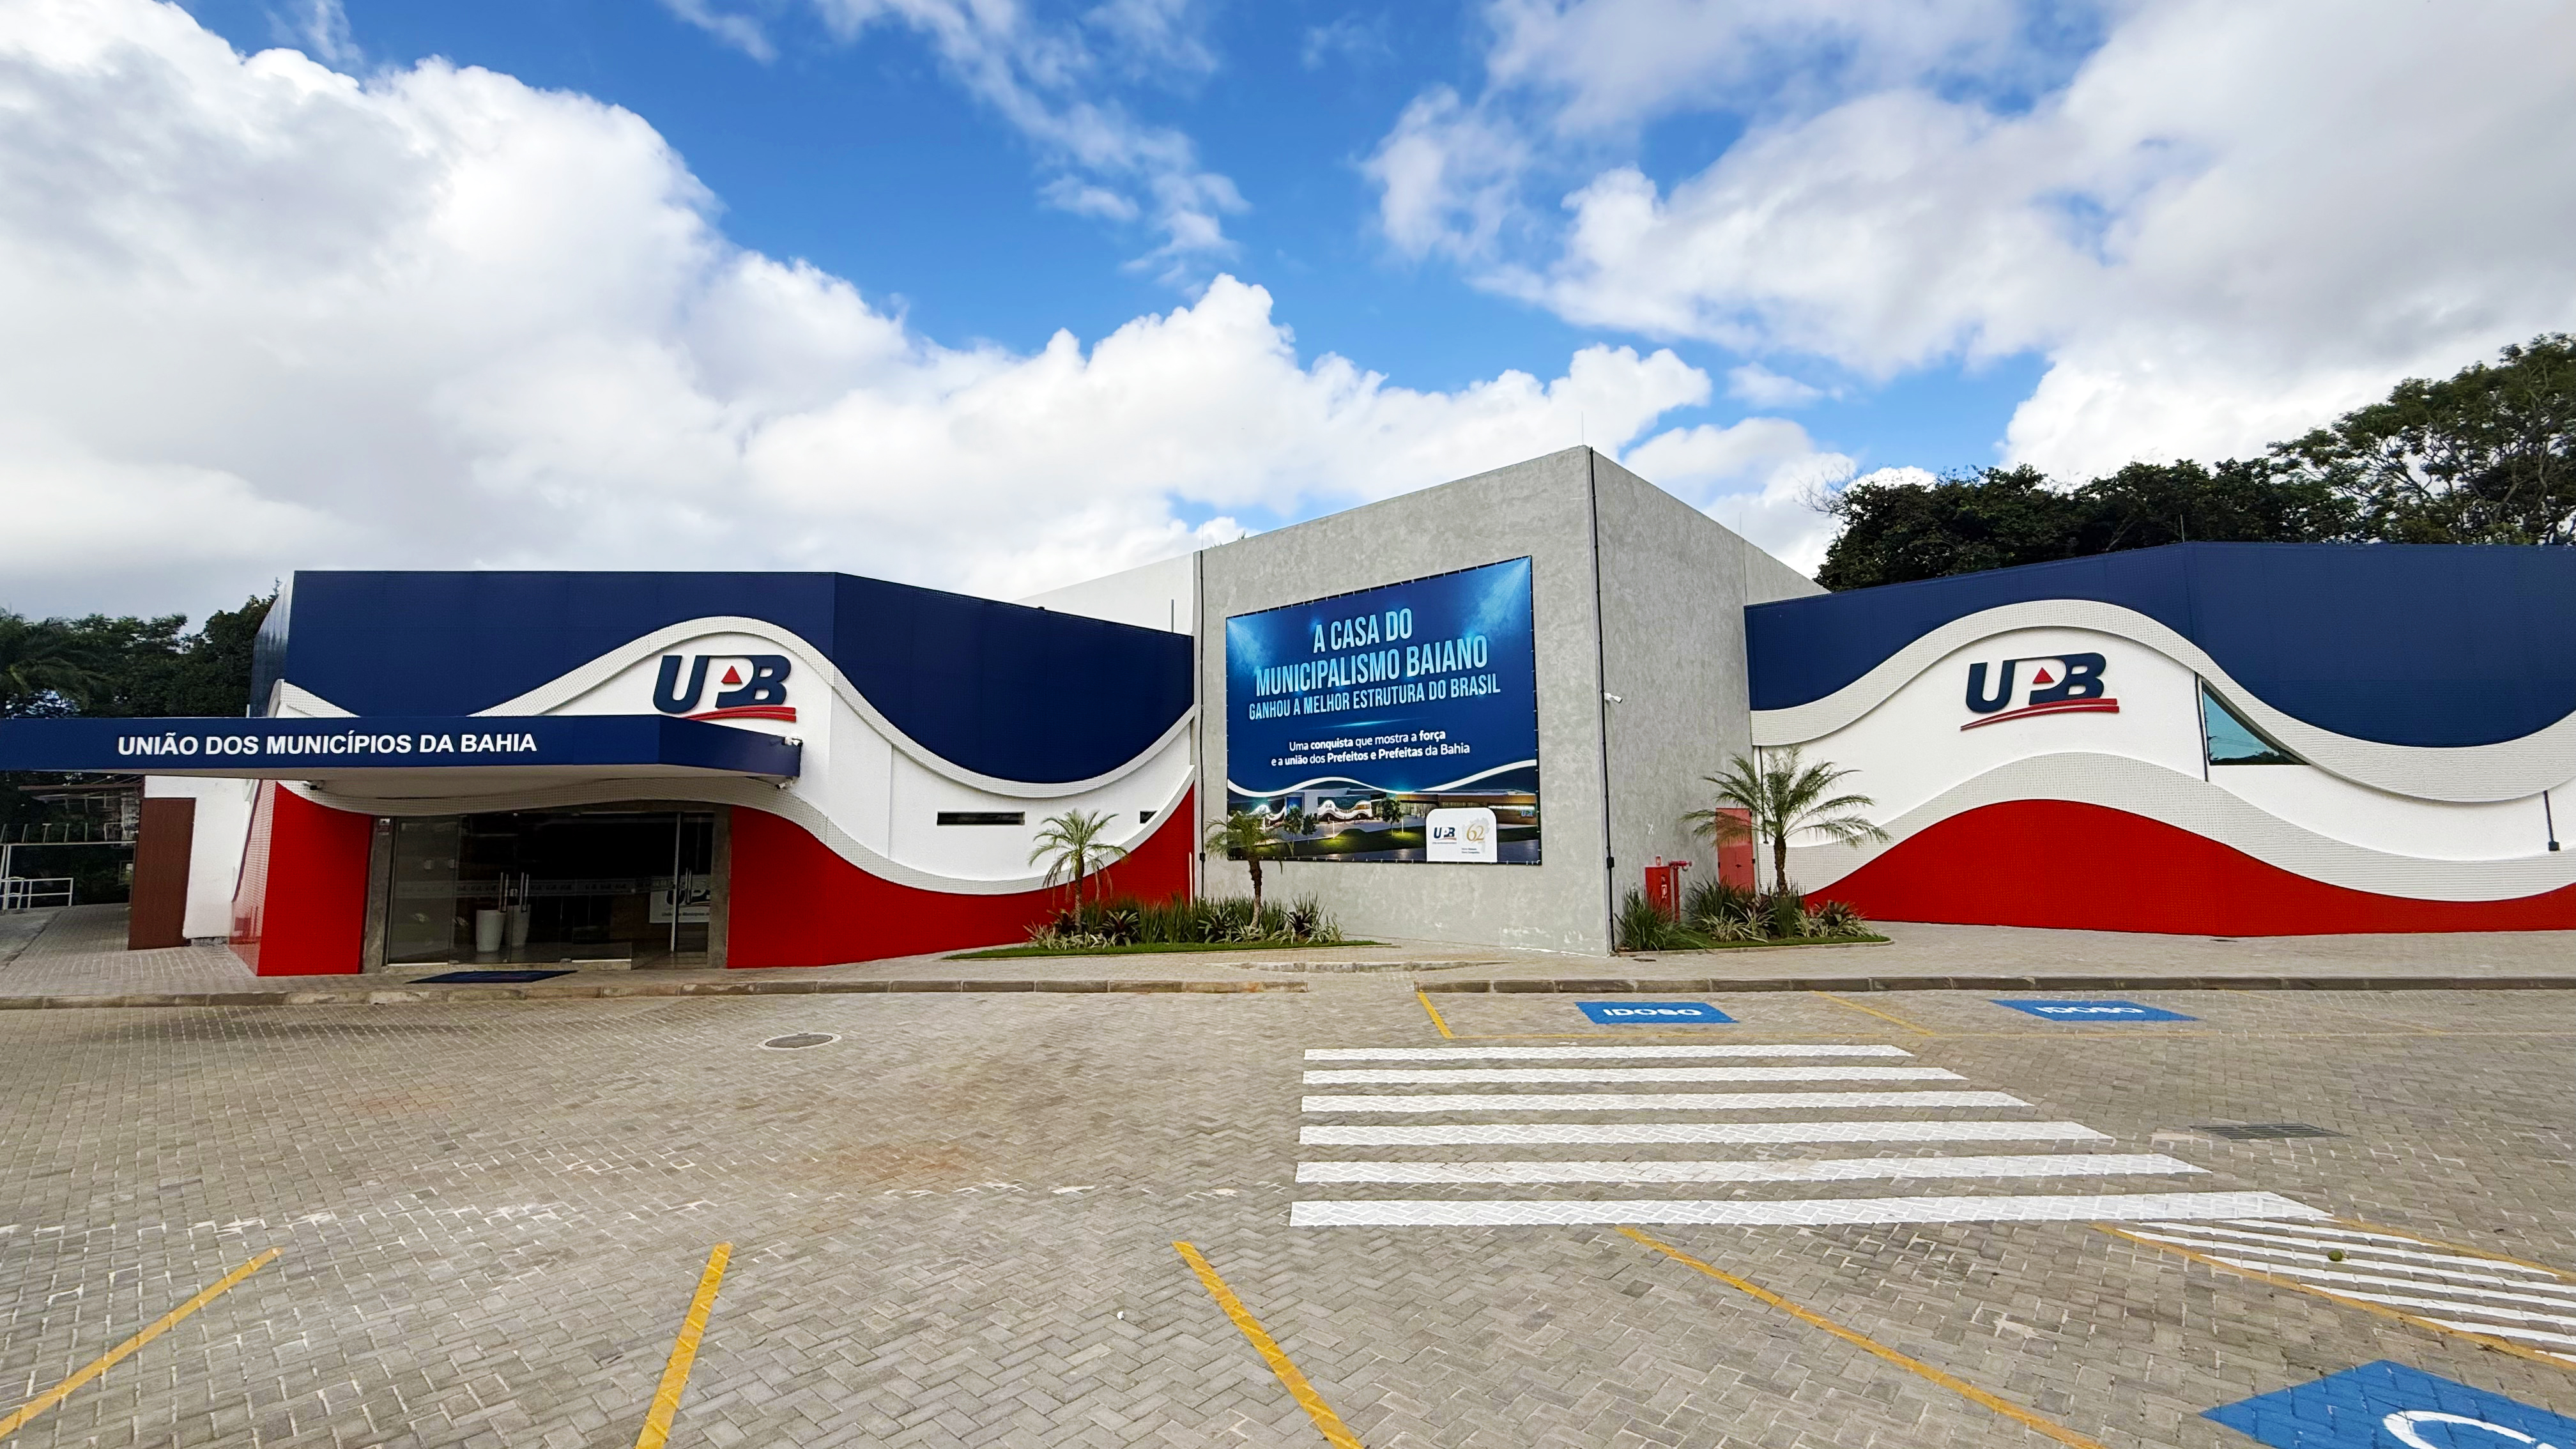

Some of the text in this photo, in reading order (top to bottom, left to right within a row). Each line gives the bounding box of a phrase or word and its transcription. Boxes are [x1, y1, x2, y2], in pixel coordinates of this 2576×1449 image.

[1313, 608, 1412, 654] A CASA DO
[1256, 634, 1487, 696] MUNICIPALISMO BAIANO
[1965, 652, 2107, 713] UPB
[652, 654, 792, 714] UPB
[1249, 673, 1500, 721] GANHOU A MELHOR ESTRUTURA DO BRASIL
[118, 730, 538, 755] UNIÃO DOS MUNICÍPIOS DA BAHIA
[1284, 754, 1308, 765] união
[1310, 753, 1326, 764] dos
[1327, 751, 1368, 762] Prefeitos
[1370, 751, 1376, 760] e
[1378, 747, 1423, 759] Prefeitas
[1425, 746, 1438, 756] da
[1440, 743, 1470, 755] Bahia
[1289, 730, 1446, 751] Uma conquista que mostra a força
[1434, 827, 1455, 839] UPB
[1467, 823, 1484, 841] 62
